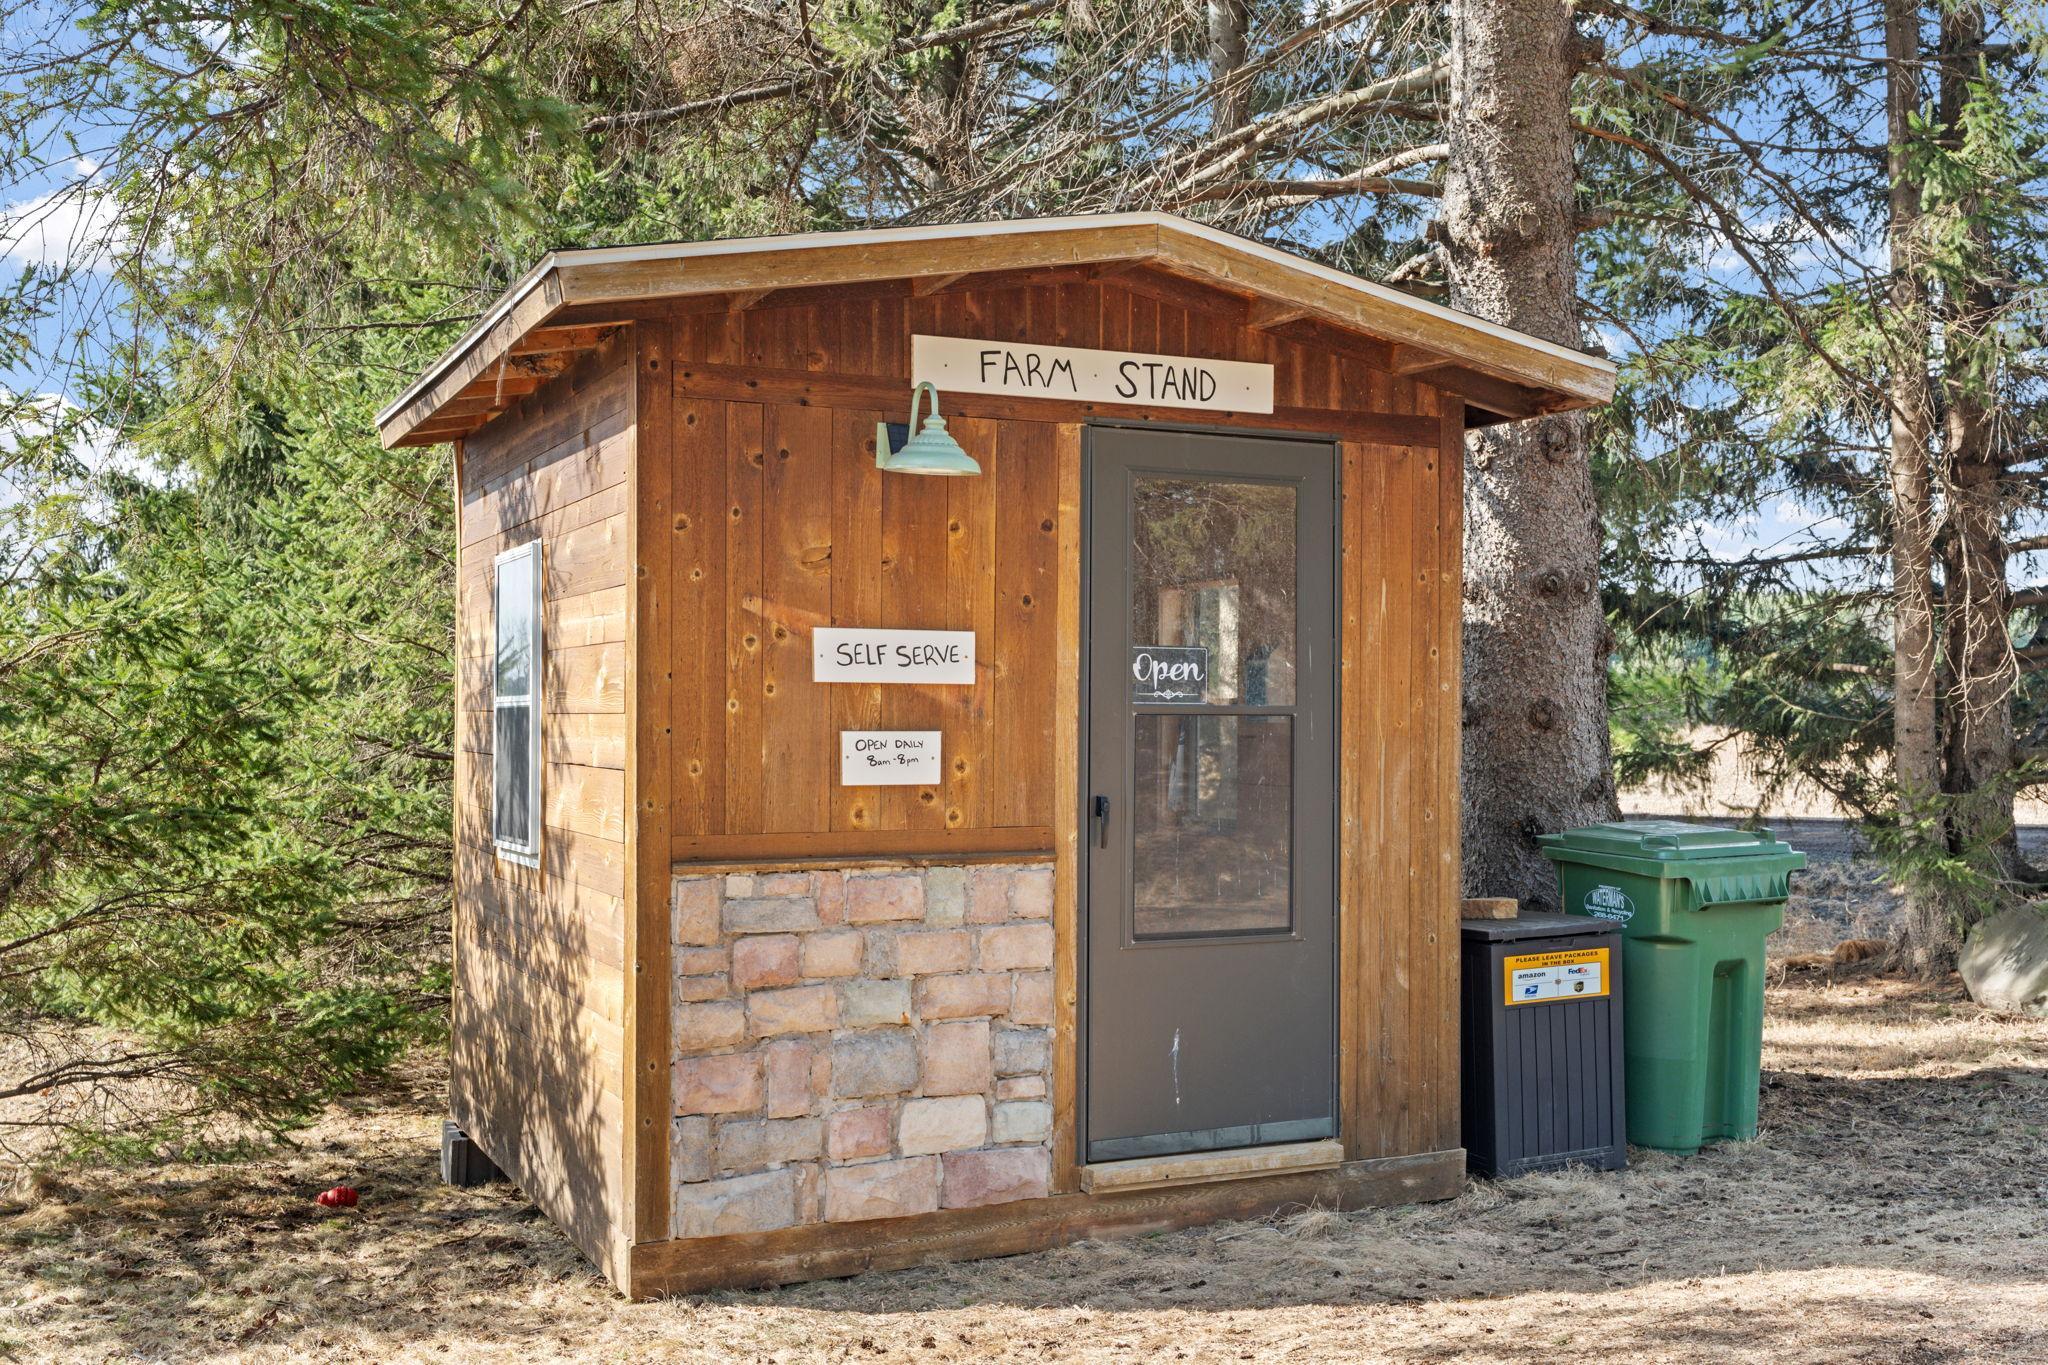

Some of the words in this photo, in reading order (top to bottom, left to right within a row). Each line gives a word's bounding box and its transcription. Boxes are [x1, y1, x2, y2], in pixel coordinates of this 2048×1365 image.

[979, 350, 1077, 392] FARM
[1115, 361, 1216, 401] STAND
[836, 643, 887, 666] SELF
[896, 645, 960, 667] SERVE
[1132, 653, 1205, 690] Open
[855, 739, 887, 751] OPEN
[895, 739, 924, 749] DAILY
[1568, 967, 1588, 975] FedEx
